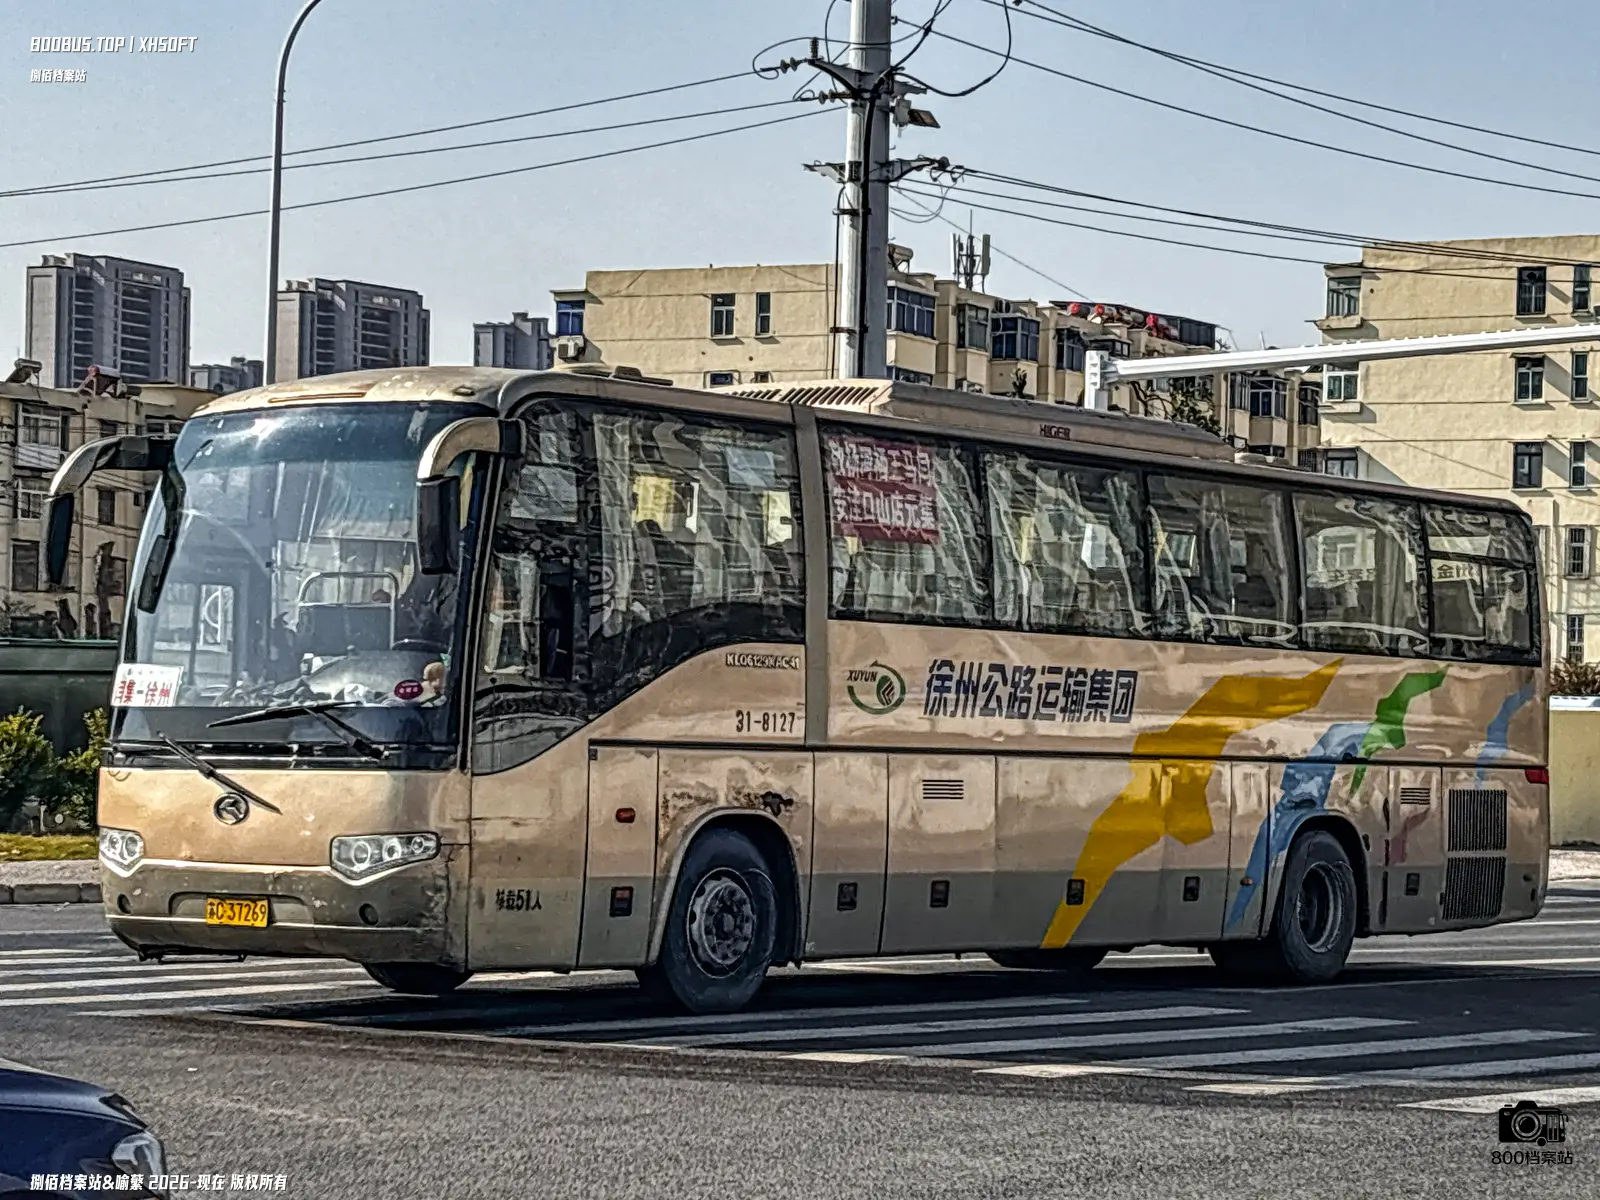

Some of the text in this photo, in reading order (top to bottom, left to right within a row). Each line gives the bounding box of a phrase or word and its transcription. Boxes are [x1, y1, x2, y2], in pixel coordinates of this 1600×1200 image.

[846, 670, 878, 682] XUYUN
[923, 659, 1138, 724] 徐州公路运输集团
[735, 710, 796, 733] 31-8127
